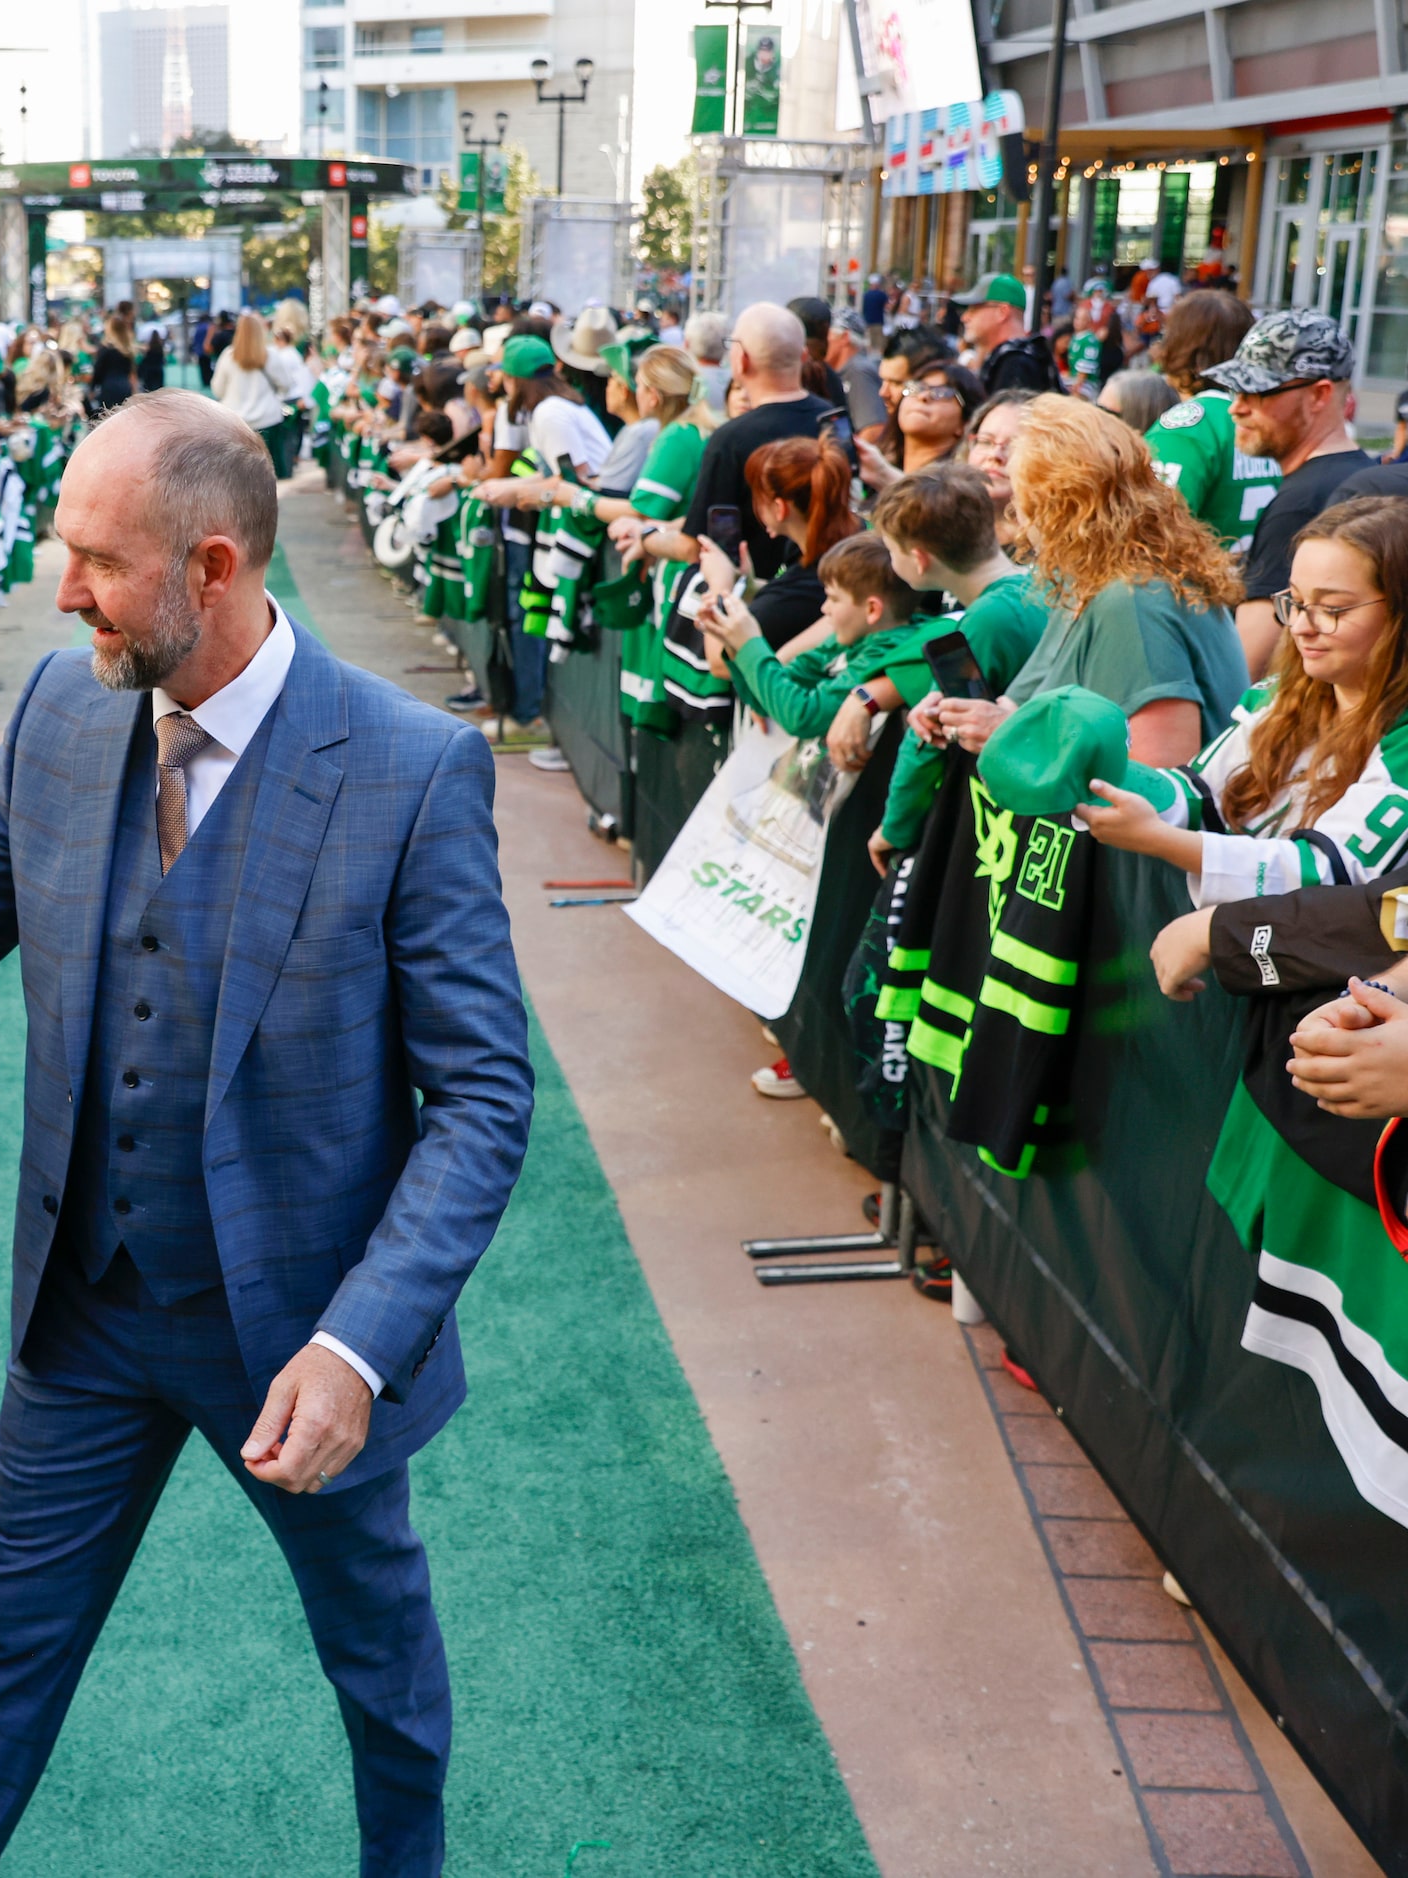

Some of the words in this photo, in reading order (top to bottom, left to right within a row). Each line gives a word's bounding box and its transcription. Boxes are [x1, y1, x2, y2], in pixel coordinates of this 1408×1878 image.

[93, 167, 140, 182] TOYOTA
[1016, 817, 1076, 911] 21
[690, 861, 807, 943] STARS
[1252, 927, 1279, 984] CCM
